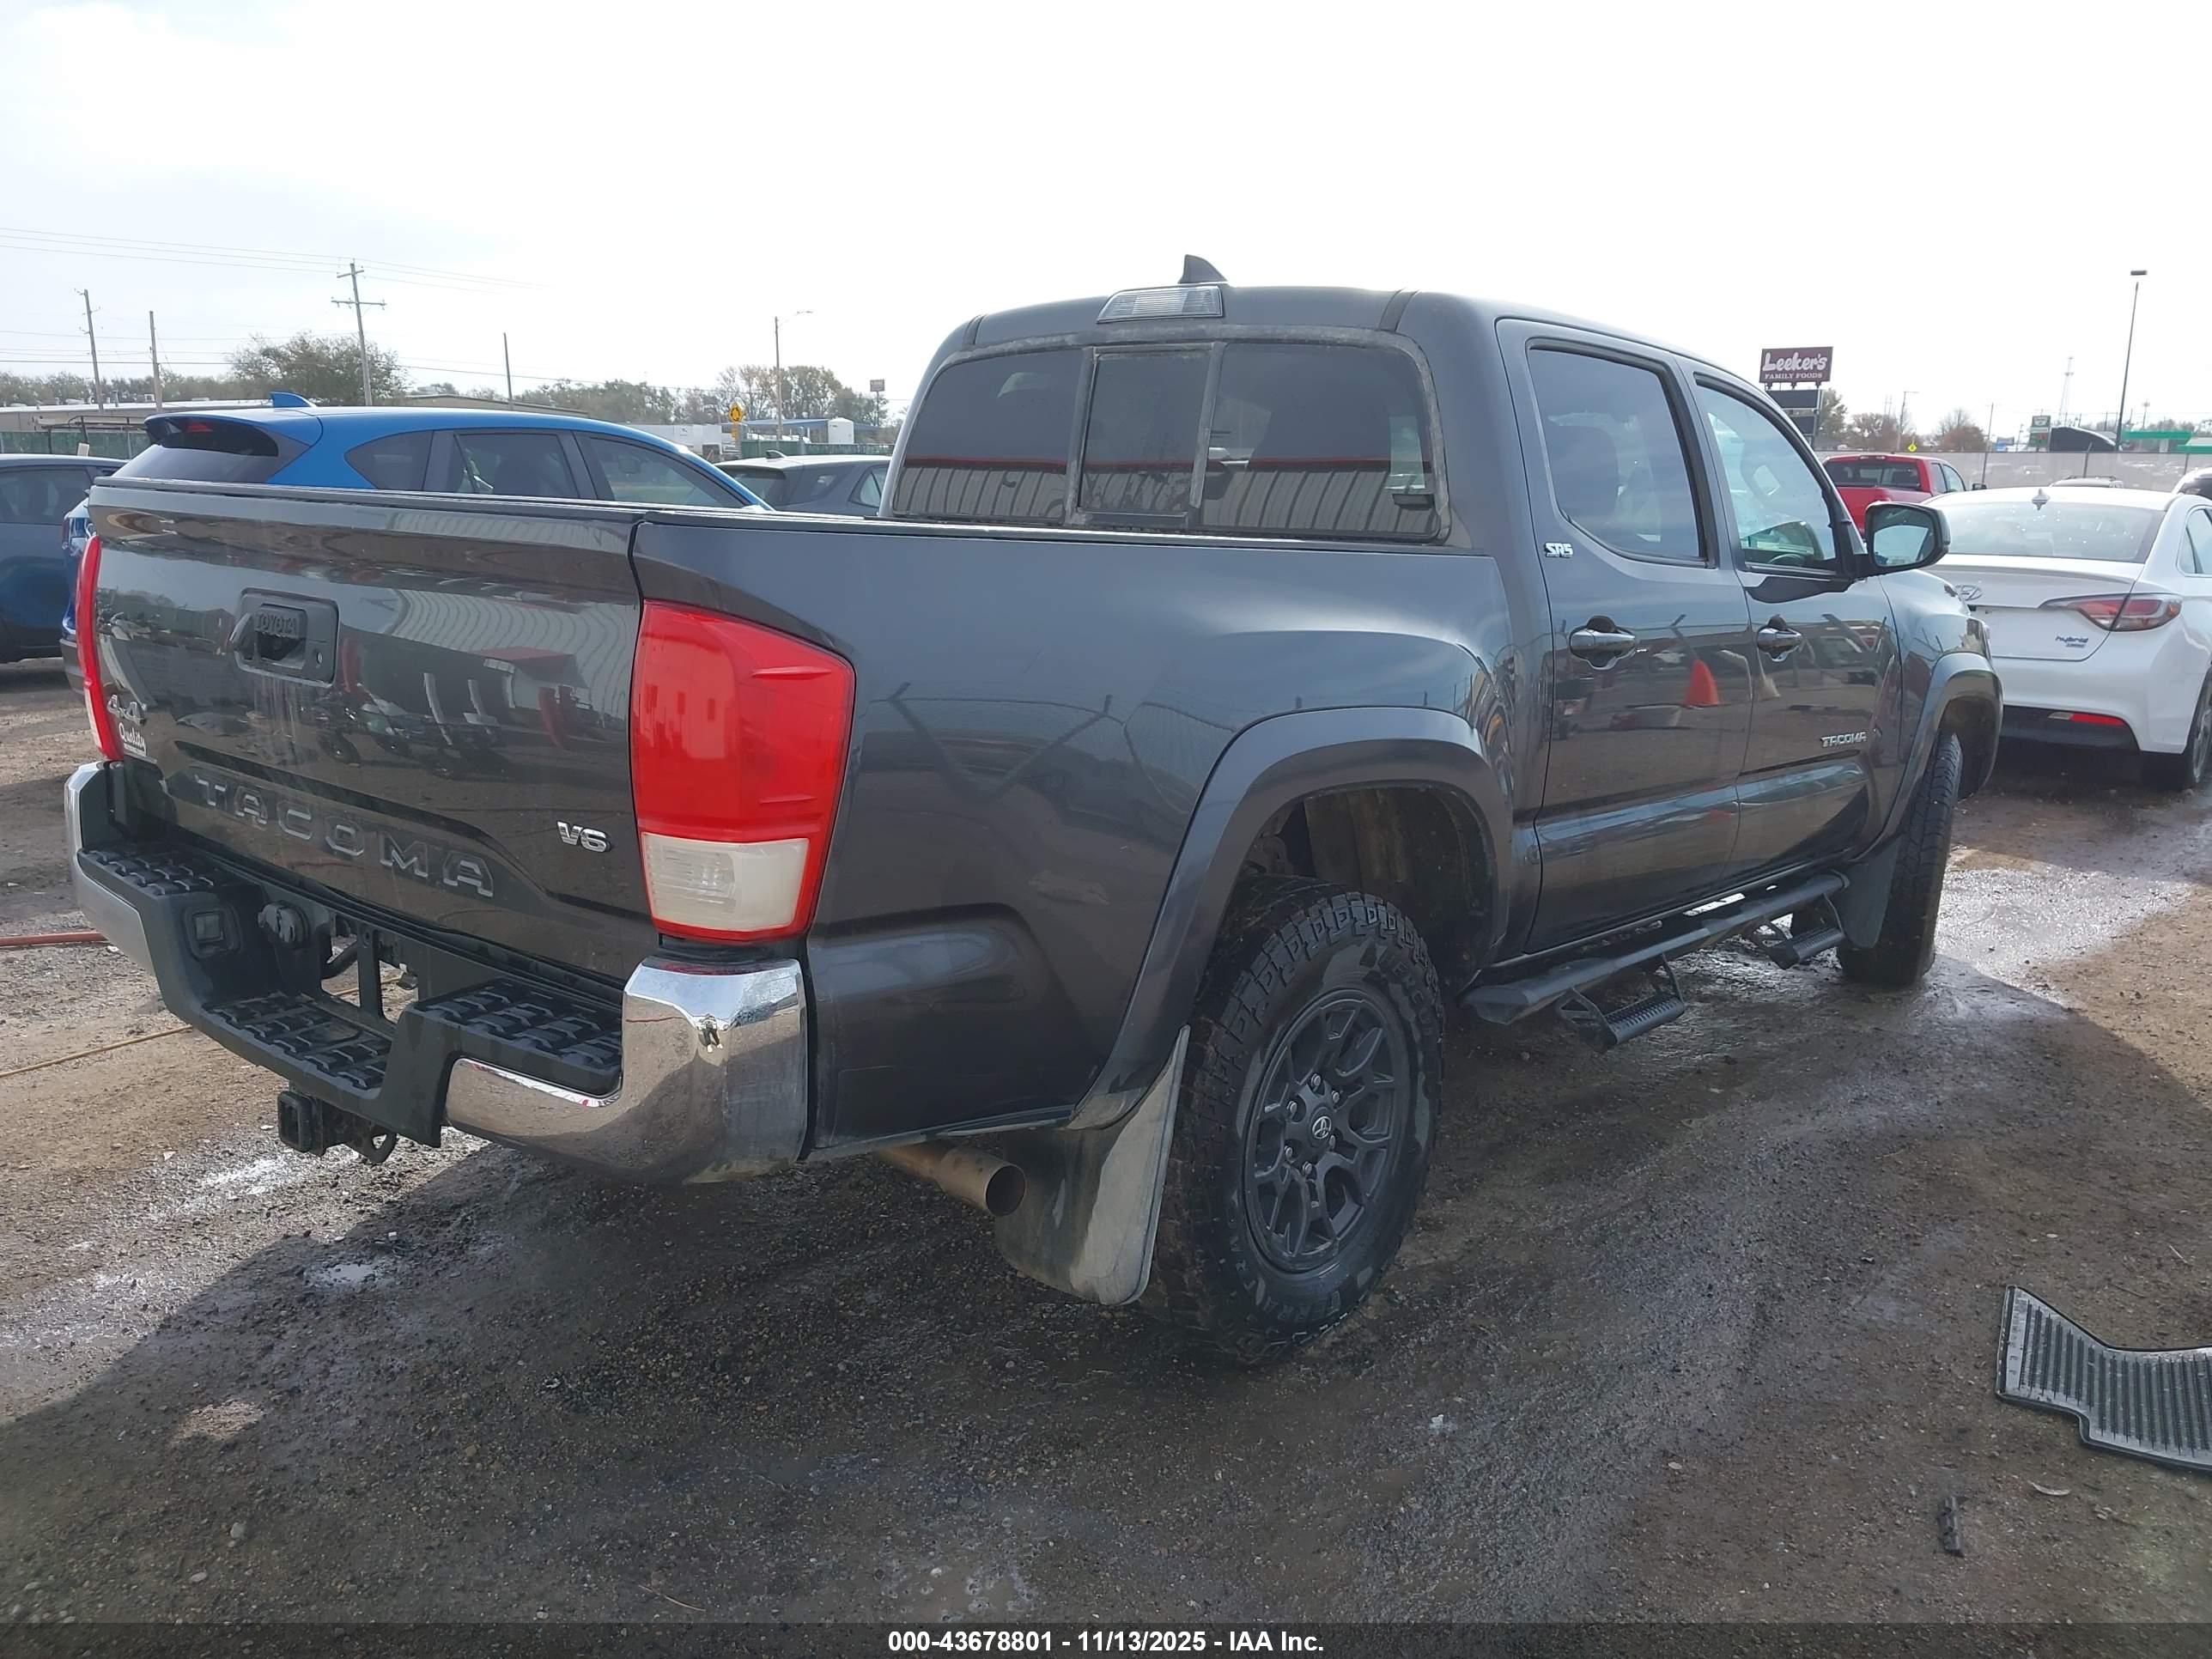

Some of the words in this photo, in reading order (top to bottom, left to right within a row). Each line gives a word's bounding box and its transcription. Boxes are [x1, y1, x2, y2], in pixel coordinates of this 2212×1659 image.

[1763, 352, 1827, 371] Leeker's
[1545, 543, 1573, 557] SR5
[256, 611, 297, 636] TOYOTA
[1820, 732, 1868, 748] TACOMA
[193, 773, 494, 898] TACOMA
[556, 820, 611, 853] V6
